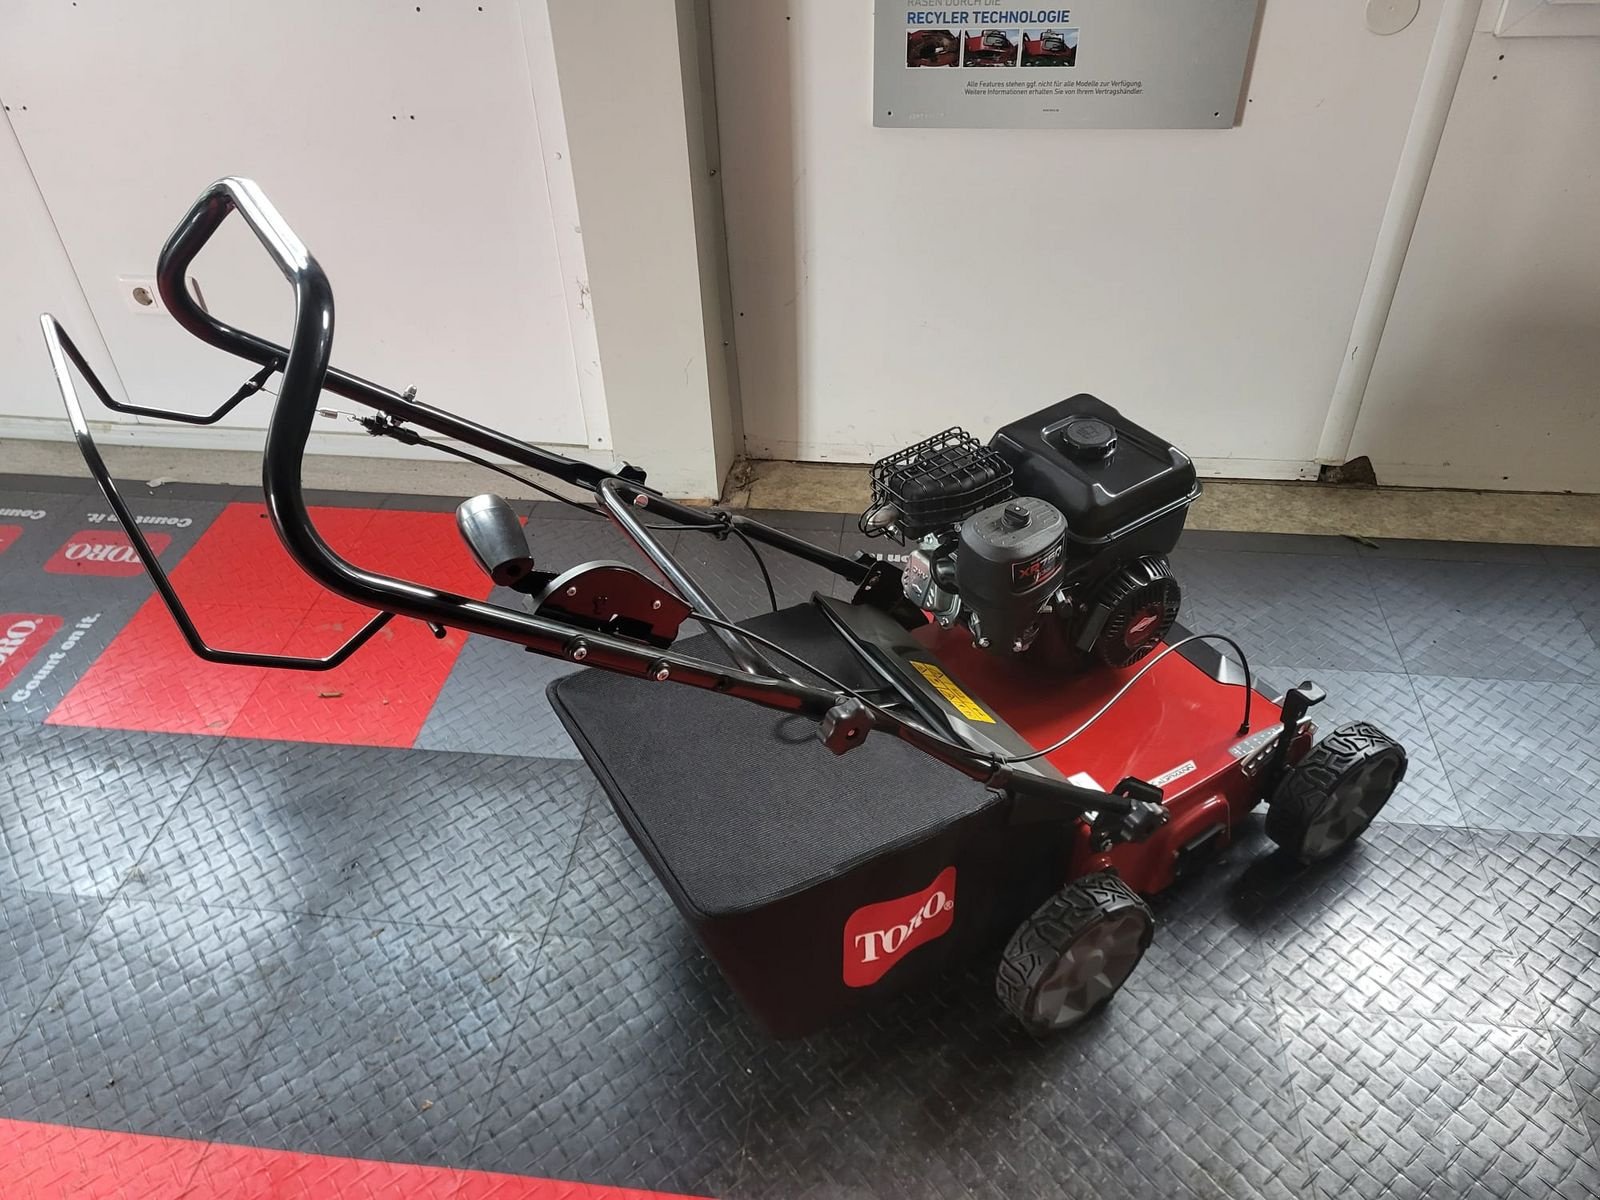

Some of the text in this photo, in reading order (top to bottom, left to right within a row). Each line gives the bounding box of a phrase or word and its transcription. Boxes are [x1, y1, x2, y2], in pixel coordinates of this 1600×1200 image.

[907, 10, 1071, 24] RECYLER TECHNOLOGIE
[0, 508, 46, 520] Coun
[134, 515, 193, 528] Count
[0, 620, 37, 667] RO
[11, 613, 101, 702] Count on it.
[854, 891, 946, 963] TORO
